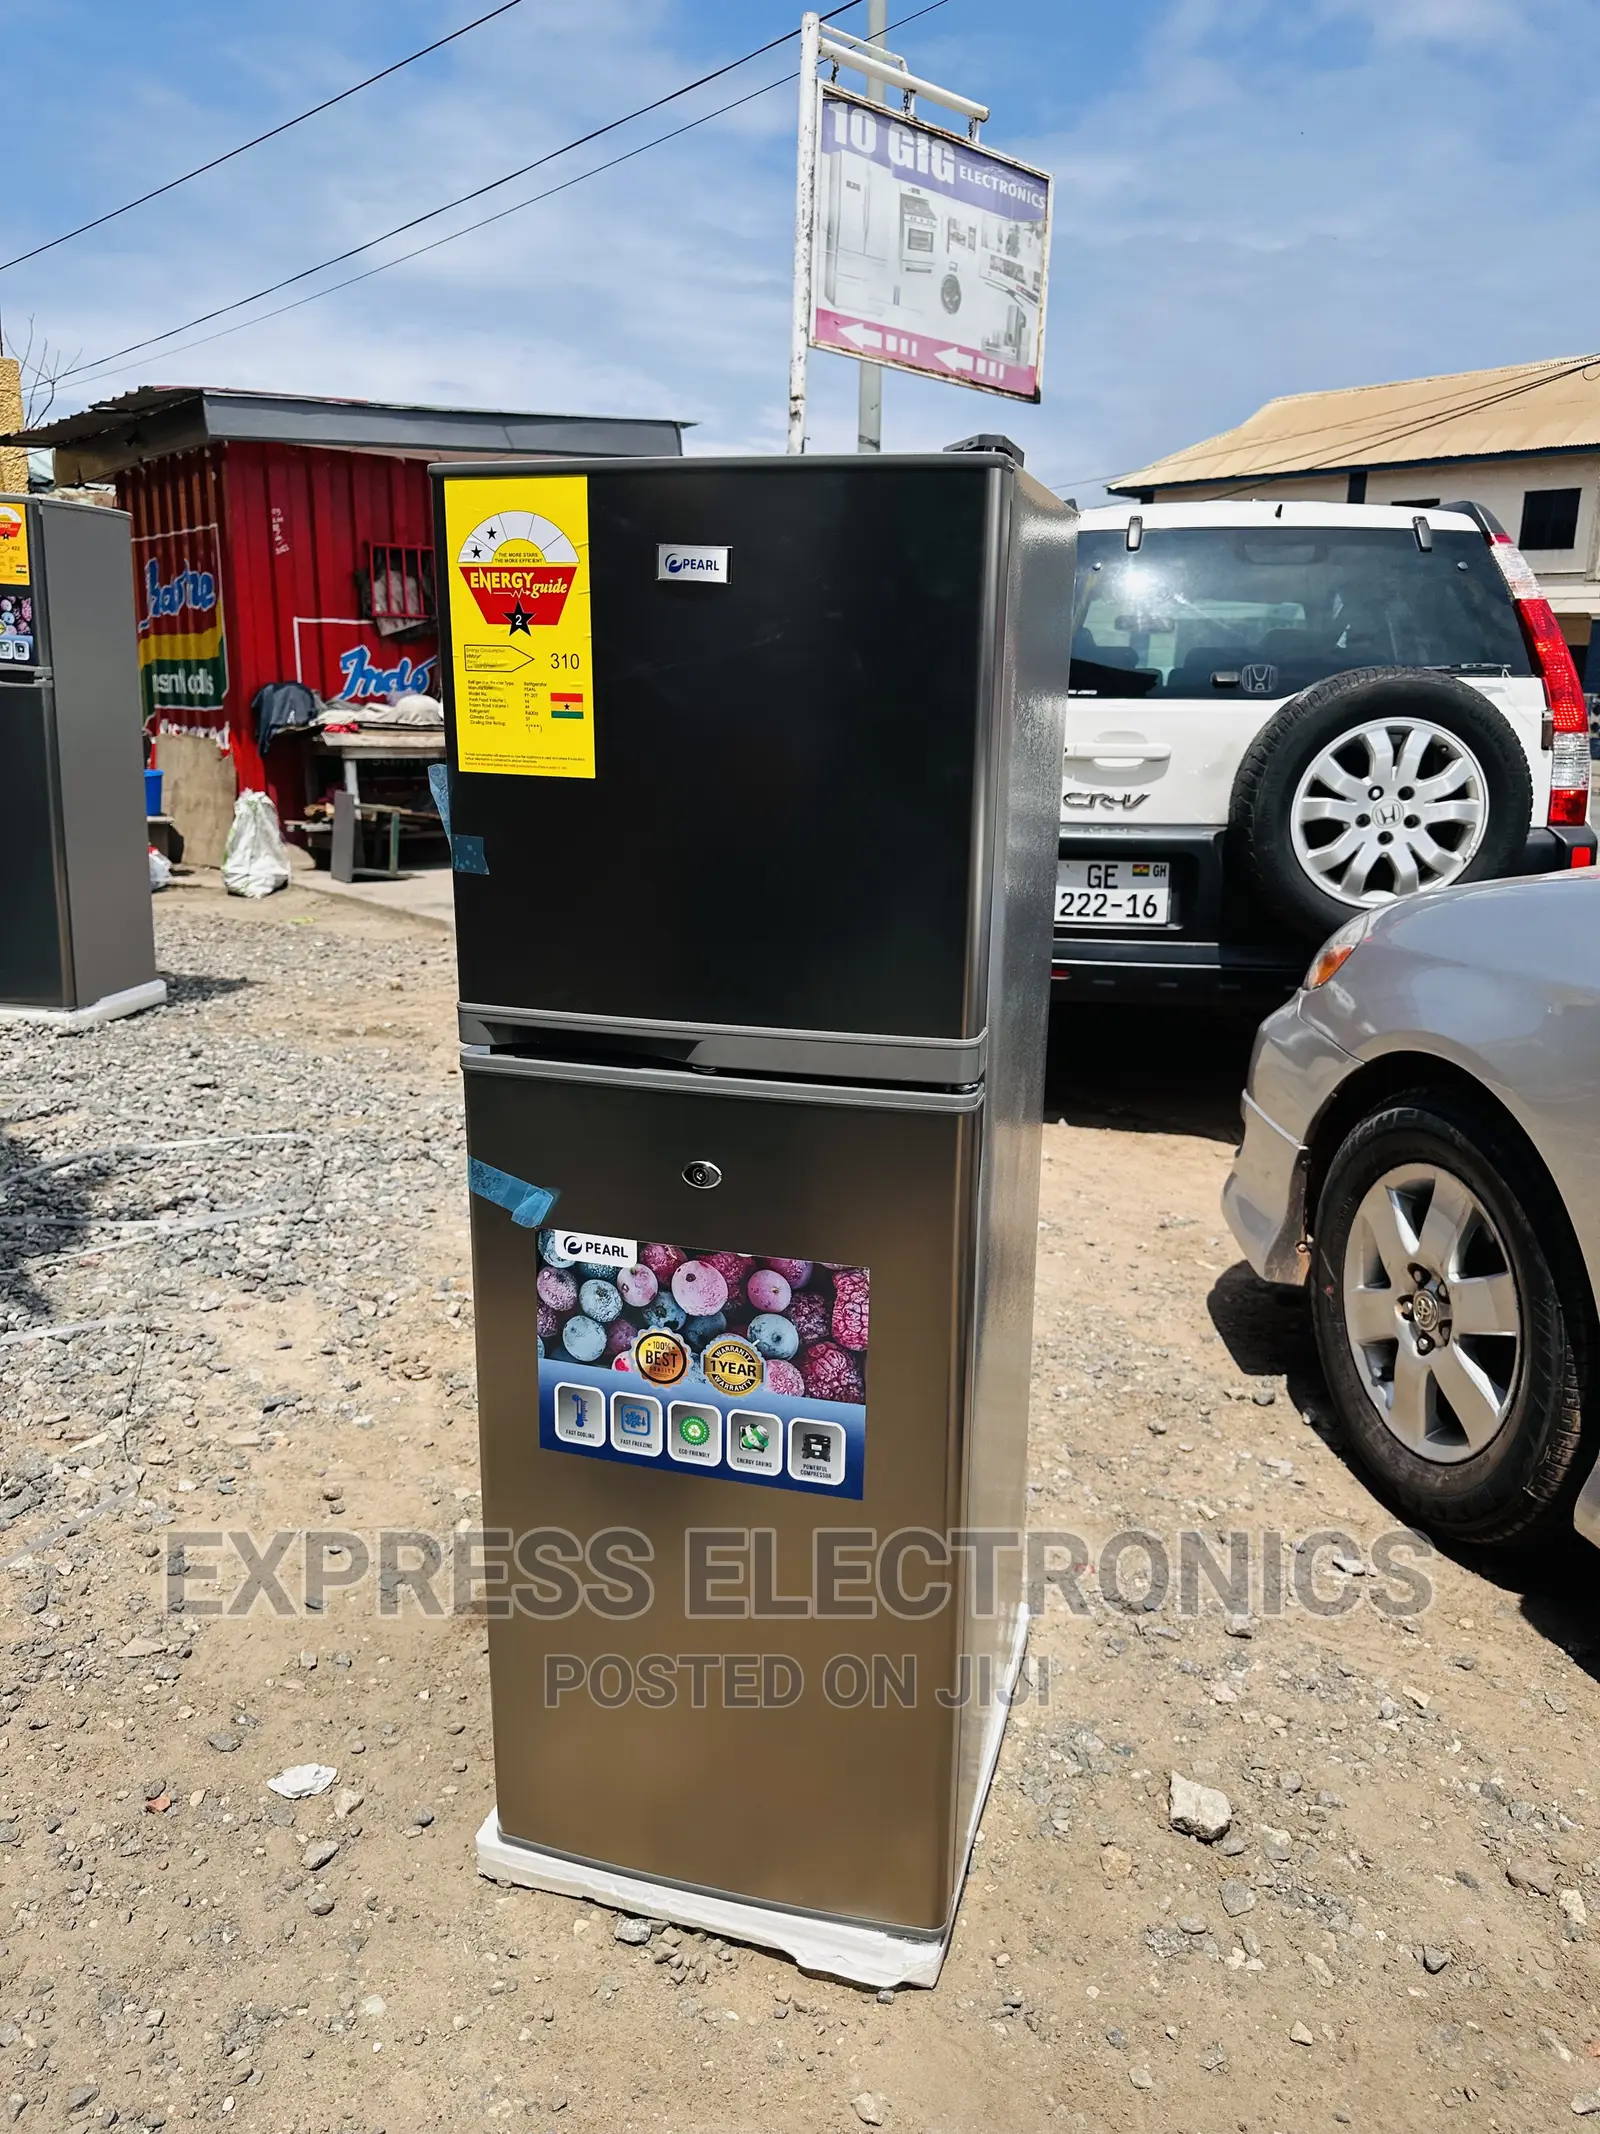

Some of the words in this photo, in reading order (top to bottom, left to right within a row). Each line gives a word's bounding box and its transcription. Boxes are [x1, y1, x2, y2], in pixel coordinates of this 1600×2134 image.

[828, 101, 877, 154] 10
[959, 164, 1046, 209] ELECTRONICS
[682, 558, 720, 571] PEARL
[470, 568, 535, 594] ENERGY
[530, 578, 567, 599] guide
[515, 614, 523, 626] 2
[550, 653, 580, 670] 310
[1063, 792, 1150, 811] CR-V
[1087, 864, 1118, 889] GE
[1153, 864, 1167, 878] GH
[1059, 892, 1158, 918] 222-16
[585, 1241, 629, 1259] PEARL
[652, 1340, 671, 1351] 100%
[714, 1346, 754, 1361] WARRANTY
[645, 1350, 678, 1368] BEST
[710, 1360, 716, 1372] 1
[718, 1360, 757, 1377] YEAR
[714, 1376, 753, 1392] WARRANTY
[565, 1428, 577, 1436] FAST
[577, 1431, 595, 1440] COOLING
[620, 1438, 631, 1446] FAST
[631, 1440, 653, 1449] FREEZING
[736, 1457, 755, 1466] ENERGY
[755, 1460, 772, 1468] SAVING
[802, 1463, 828, 1473] POWERFUL
[800, 1469, 832, 1479] COMPRESSOR
